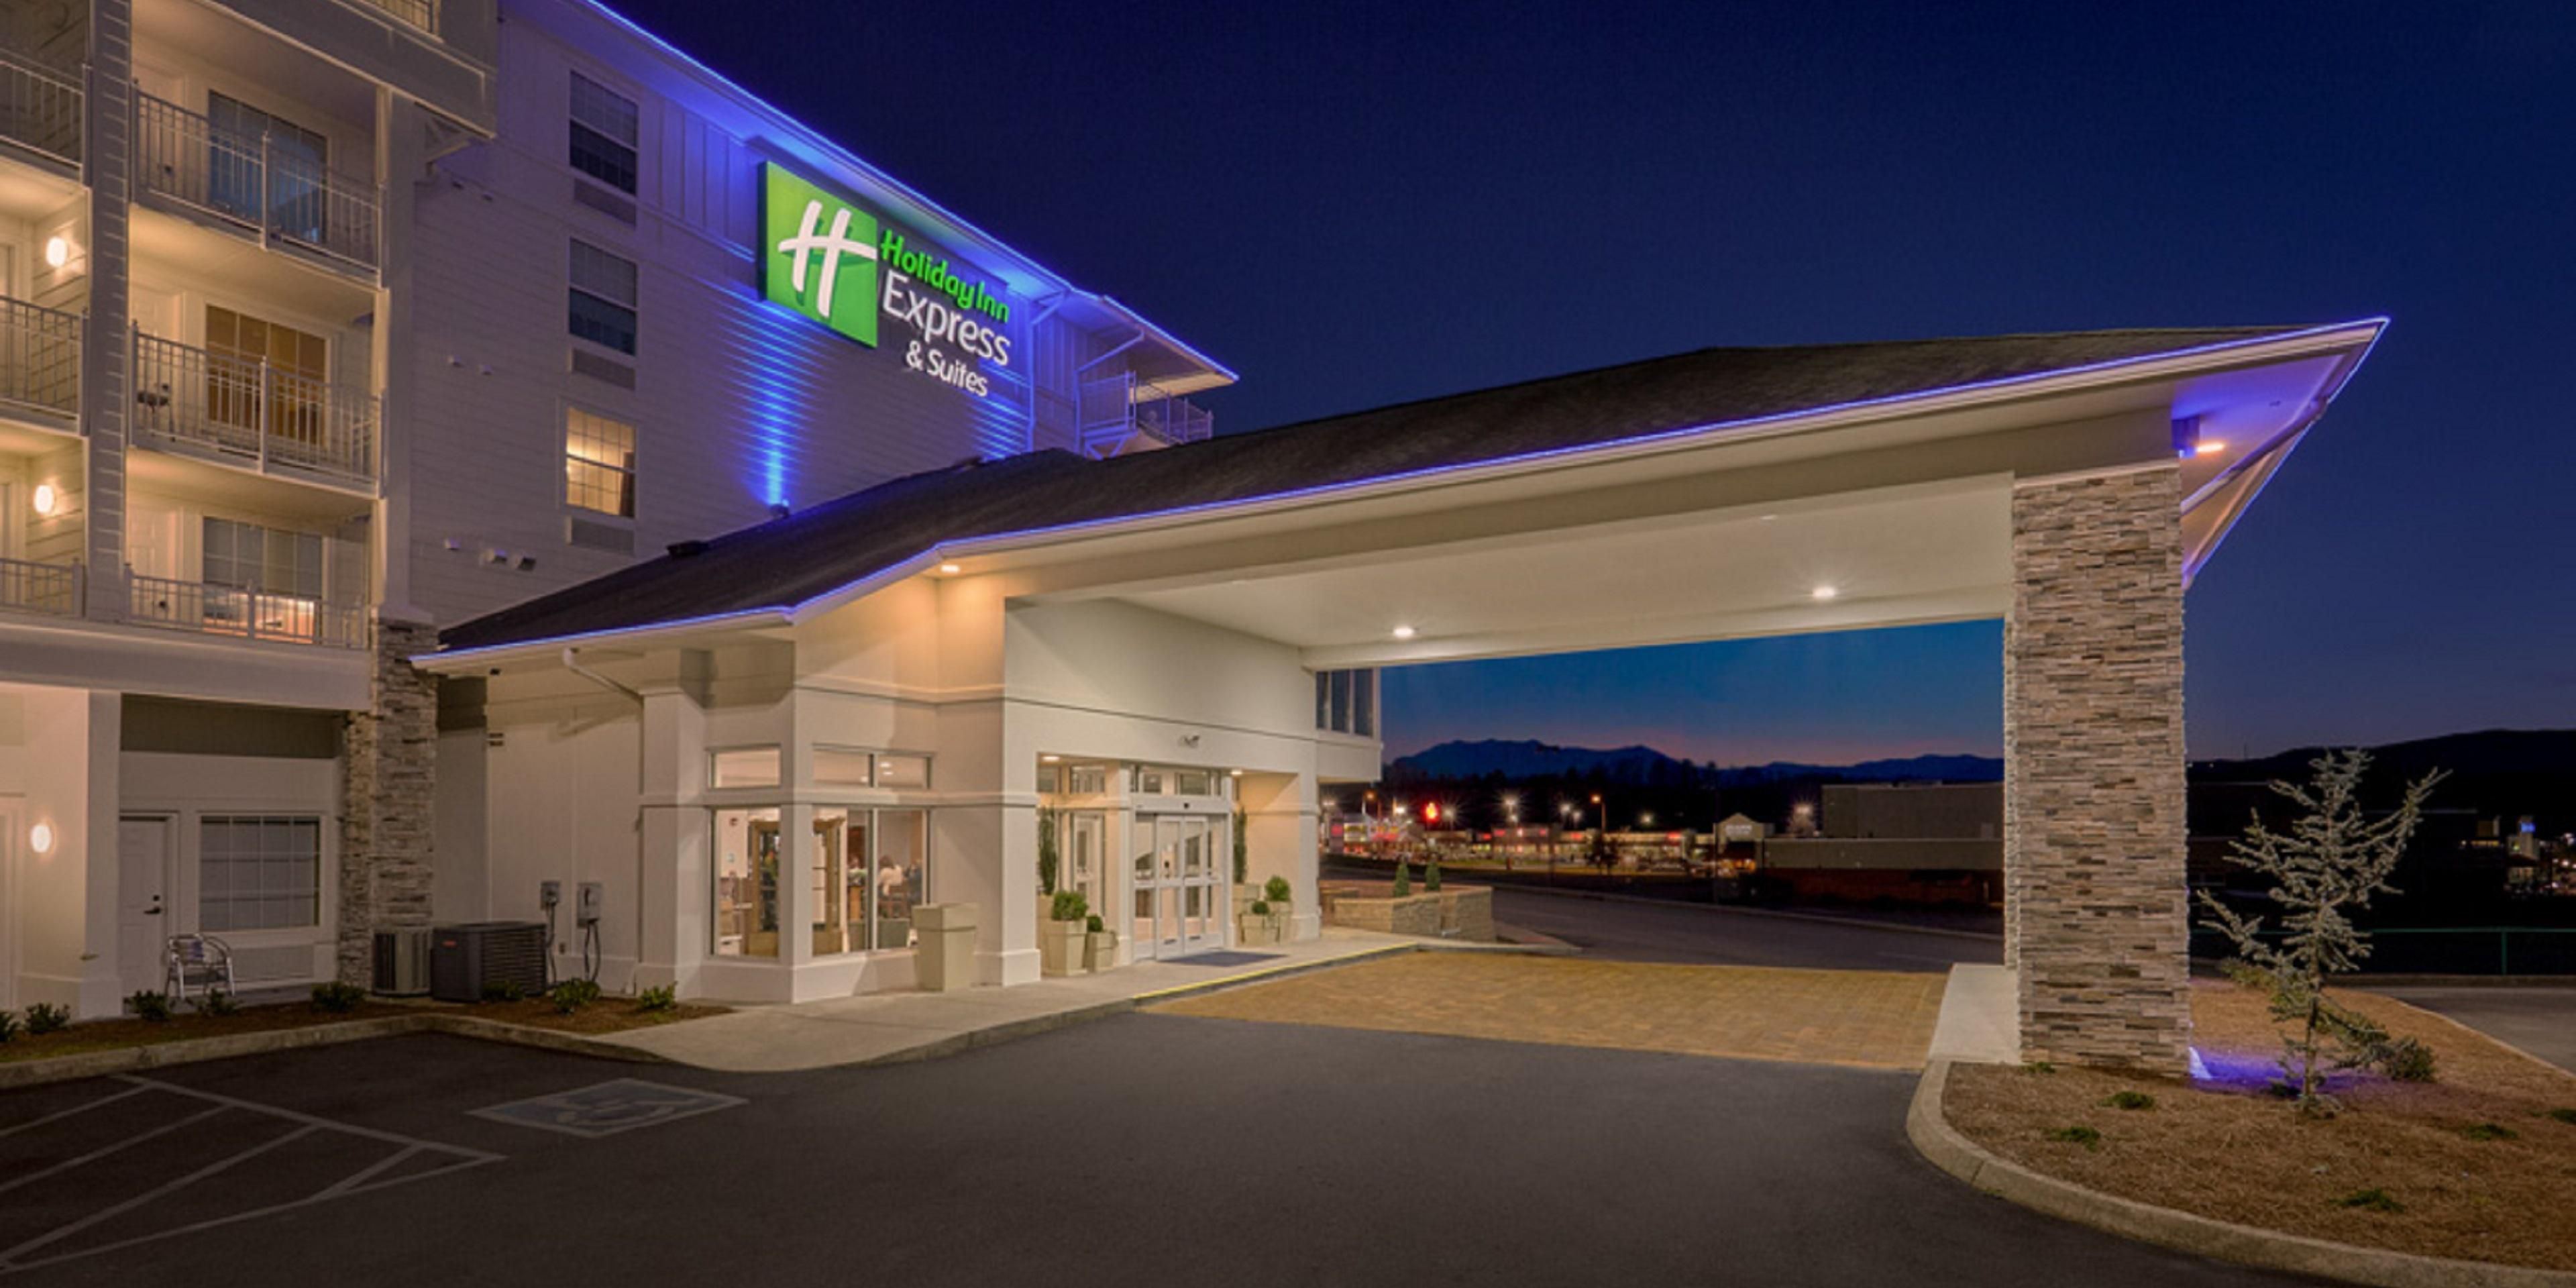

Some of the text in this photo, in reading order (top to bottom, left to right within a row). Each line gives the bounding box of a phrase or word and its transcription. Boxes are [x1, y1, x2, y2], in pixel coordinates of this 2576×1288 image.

[881, 229, 1009, 323] Holiday Inn
[883, 270, 1010, 366] Express
[906, 340, 987, 396] & Suites
